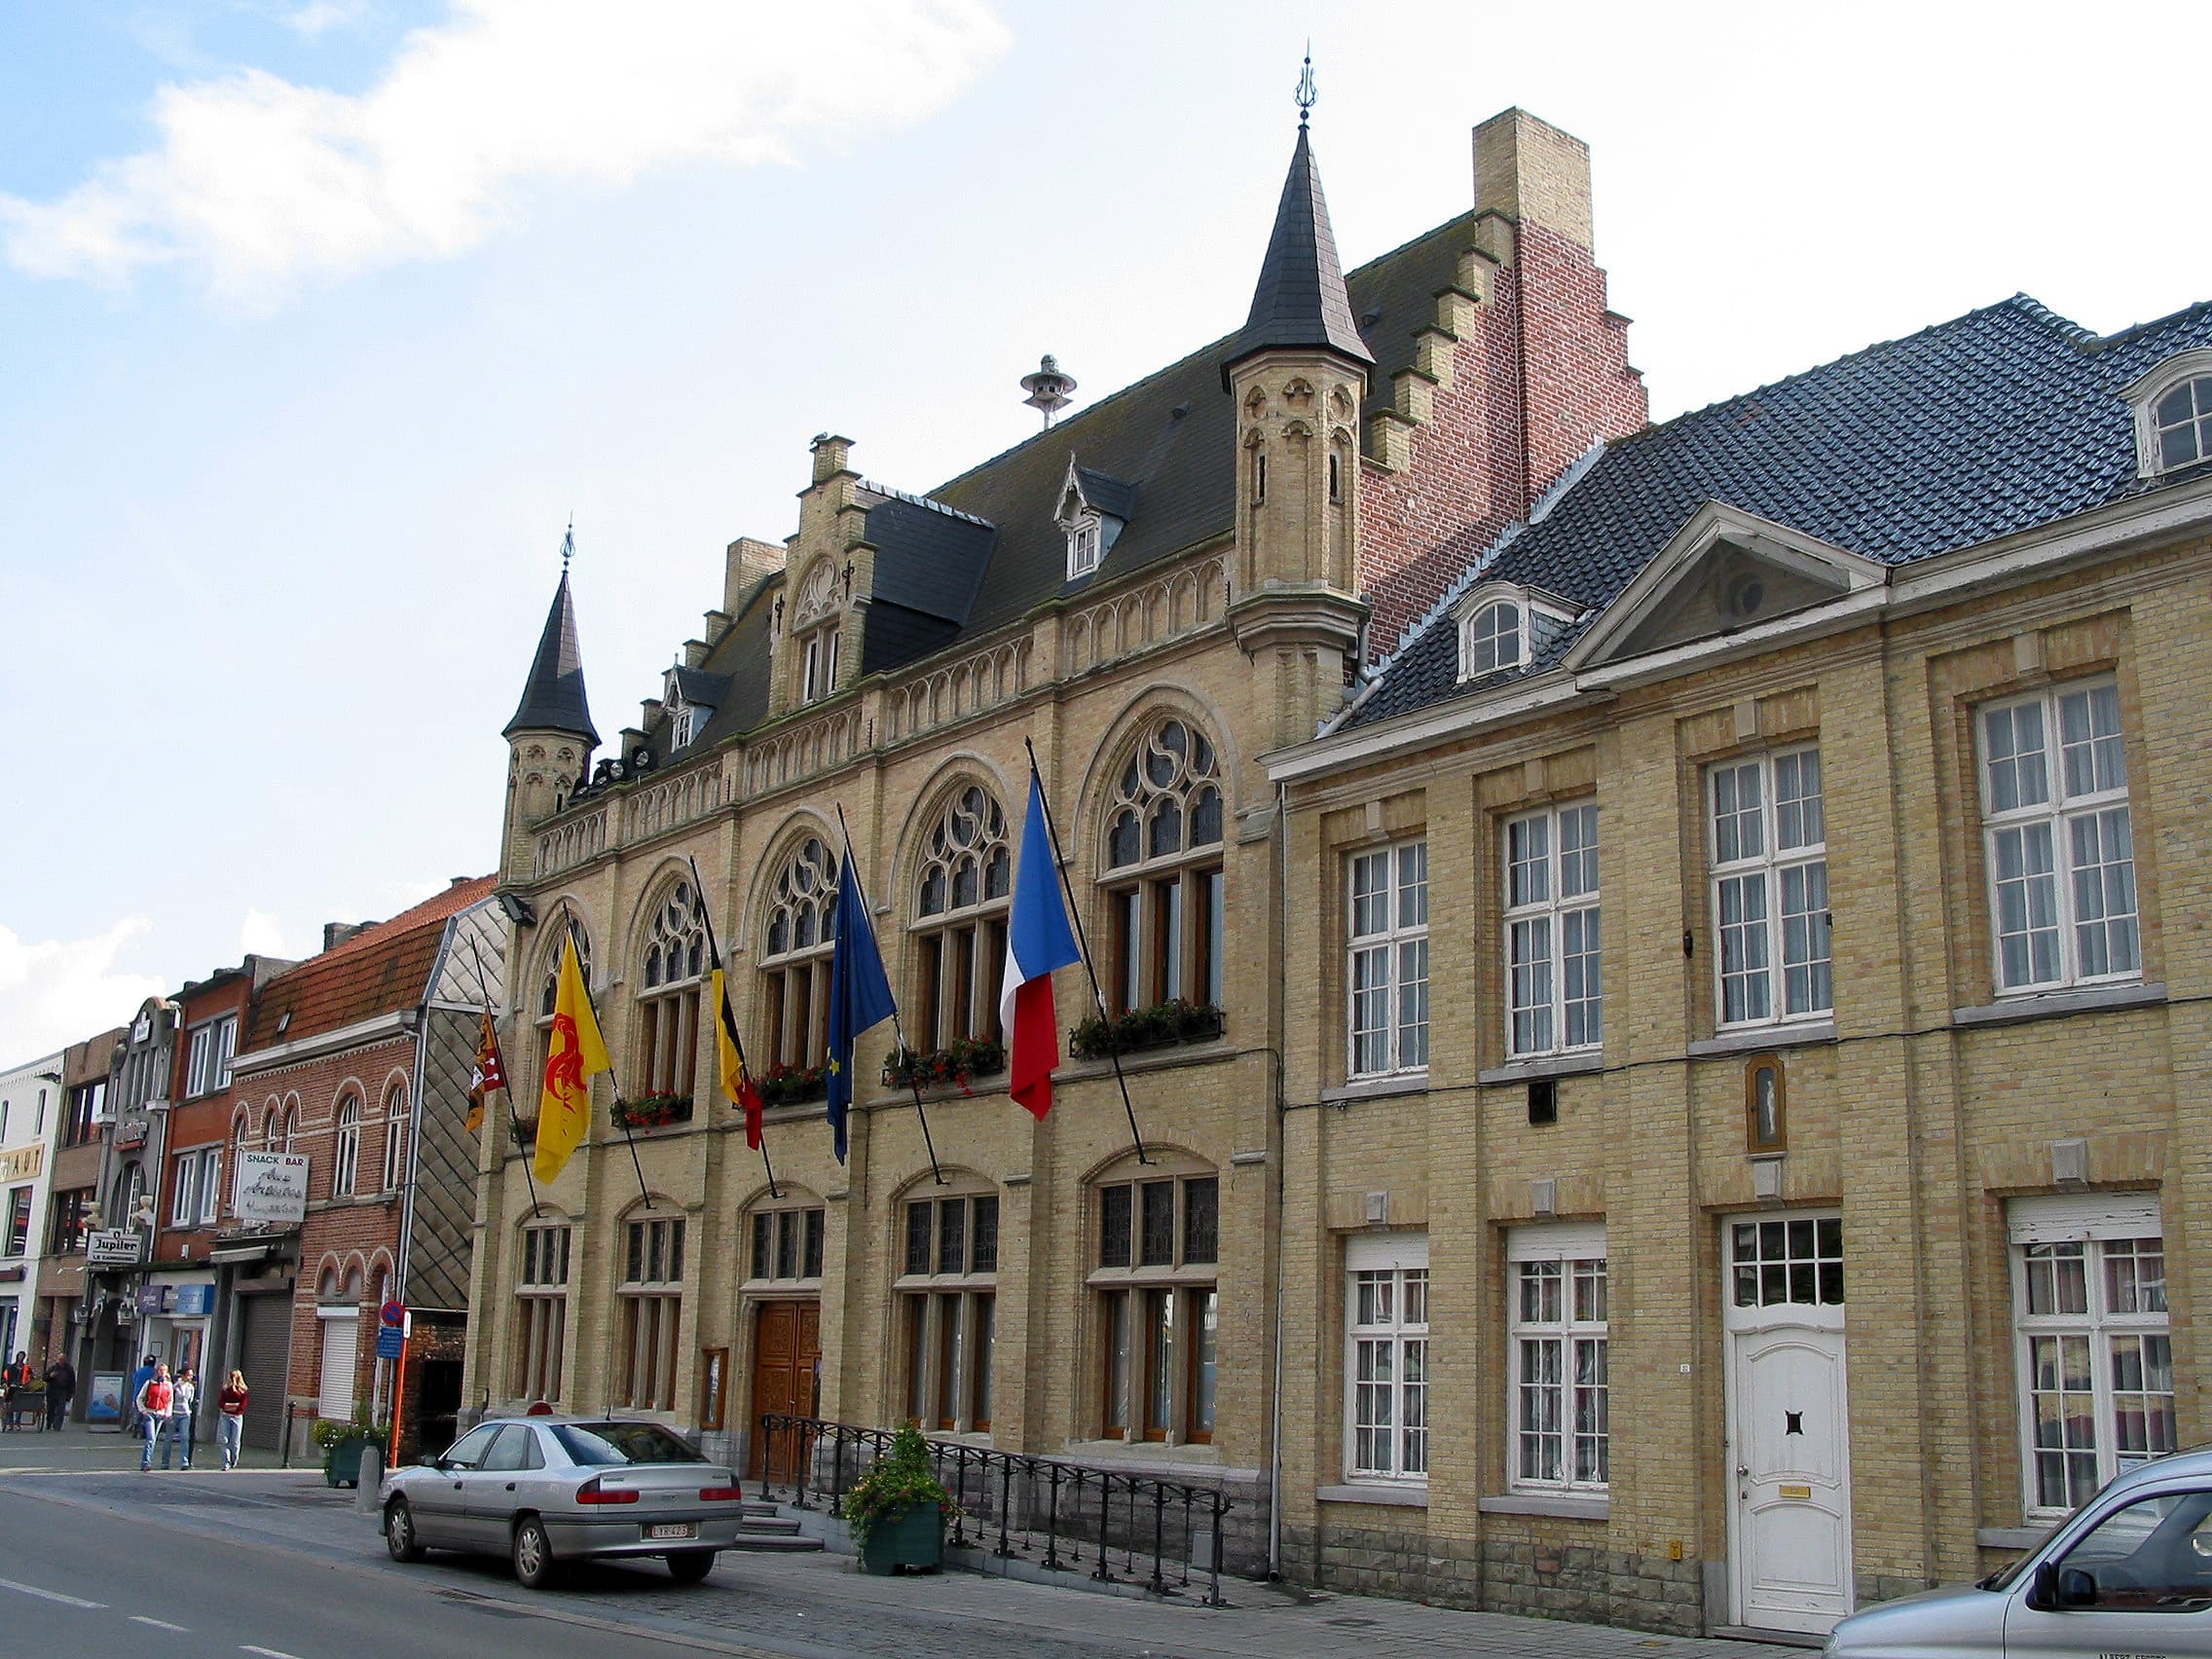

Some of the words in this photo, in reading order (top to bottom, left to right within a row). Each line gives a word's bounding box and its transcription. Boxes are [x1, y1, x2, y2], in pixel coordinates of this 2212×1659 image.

[246, 1154, 279, 1165] SNACK
[285, 1157, 305, 1166] BAR
[95, 1238, 137, 1251] Jupiler
